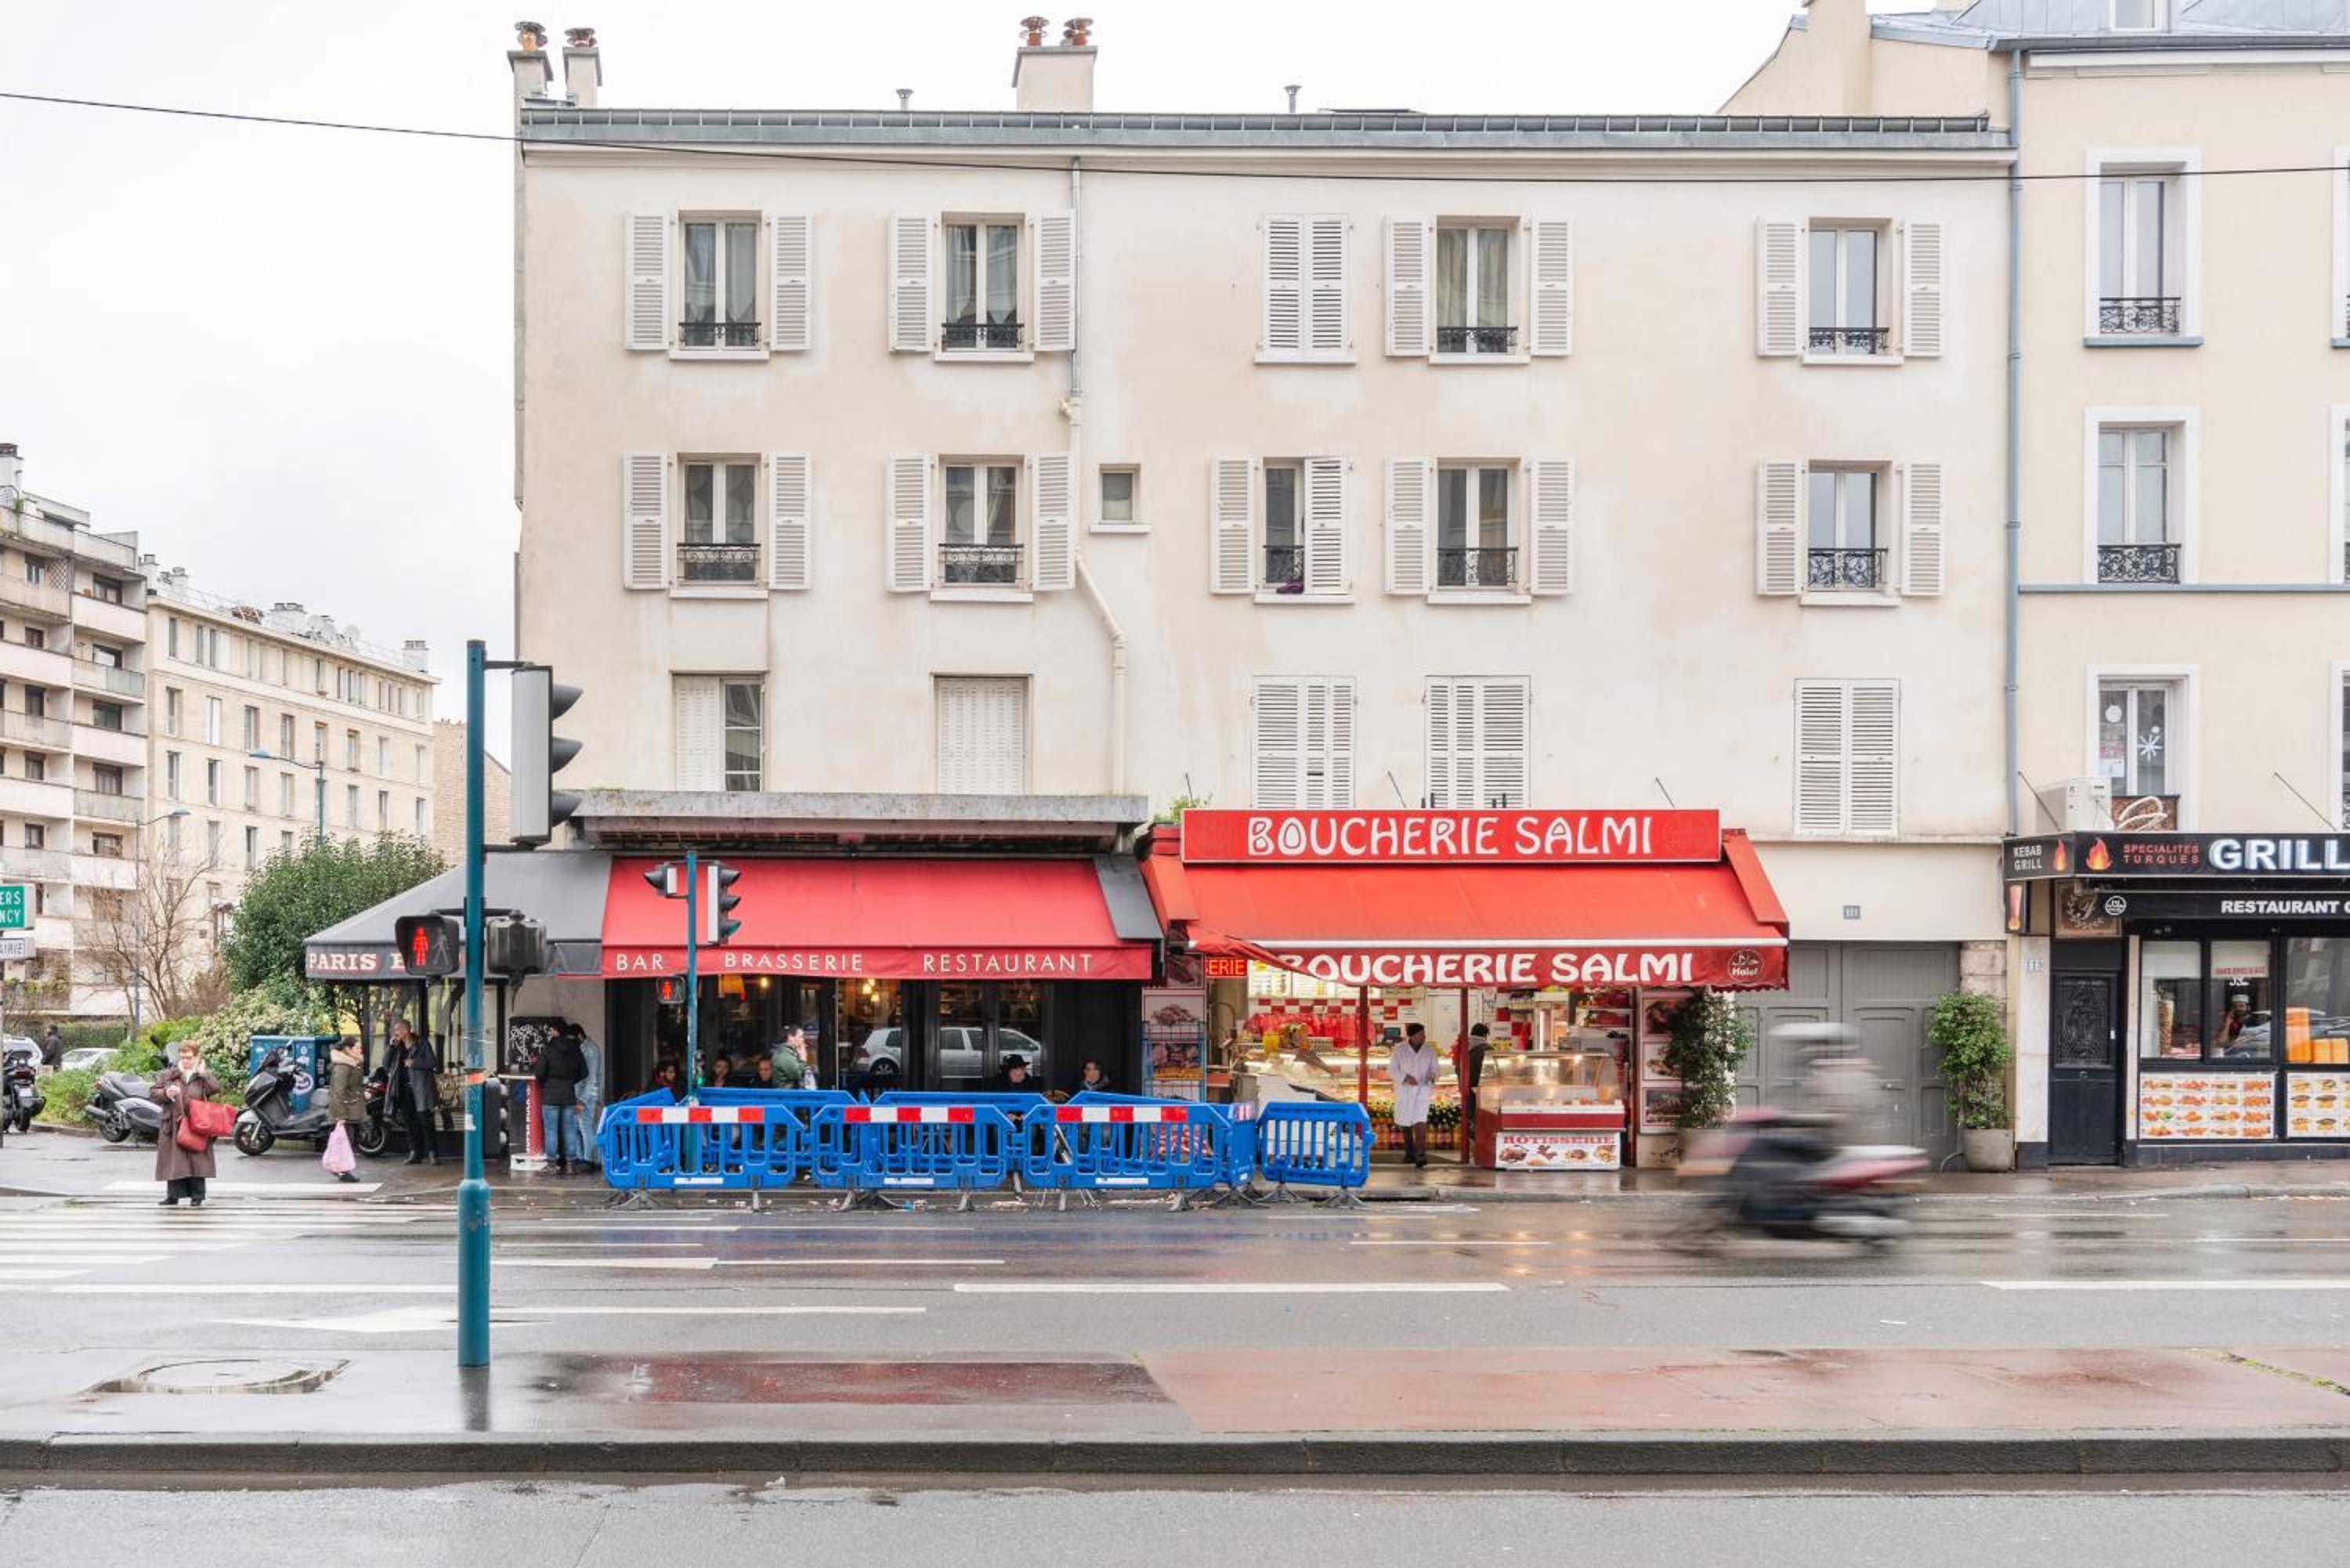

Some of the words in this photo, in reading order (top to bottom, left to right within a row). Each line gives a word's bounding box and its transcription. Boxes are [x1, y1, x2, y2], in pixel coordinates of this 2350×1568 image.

[1248, 817, 1497, 856] BOUCHERIE
[1516, 817, 1652, 854] SALMI
[2013, 844, 2042, 858] KEBAB
[2123, 854, 2200, 864] TURQUES
[2208, 839, 2350, 870] GRILL
[2014, 858, 2043, 871] GRILL
[2221, 901, 2340, 914] RESTAURANT
[309, 953, 377, 970] PARIS
[616, 953, 664, 970] BAR
[725, 953, 862, 971] BRASSERIE
[923, 953, 1093, 972] RESTAURANT
[1205, 959, 1246, 976] ERIE
[1550, 952, 1694, 981] SALMI
